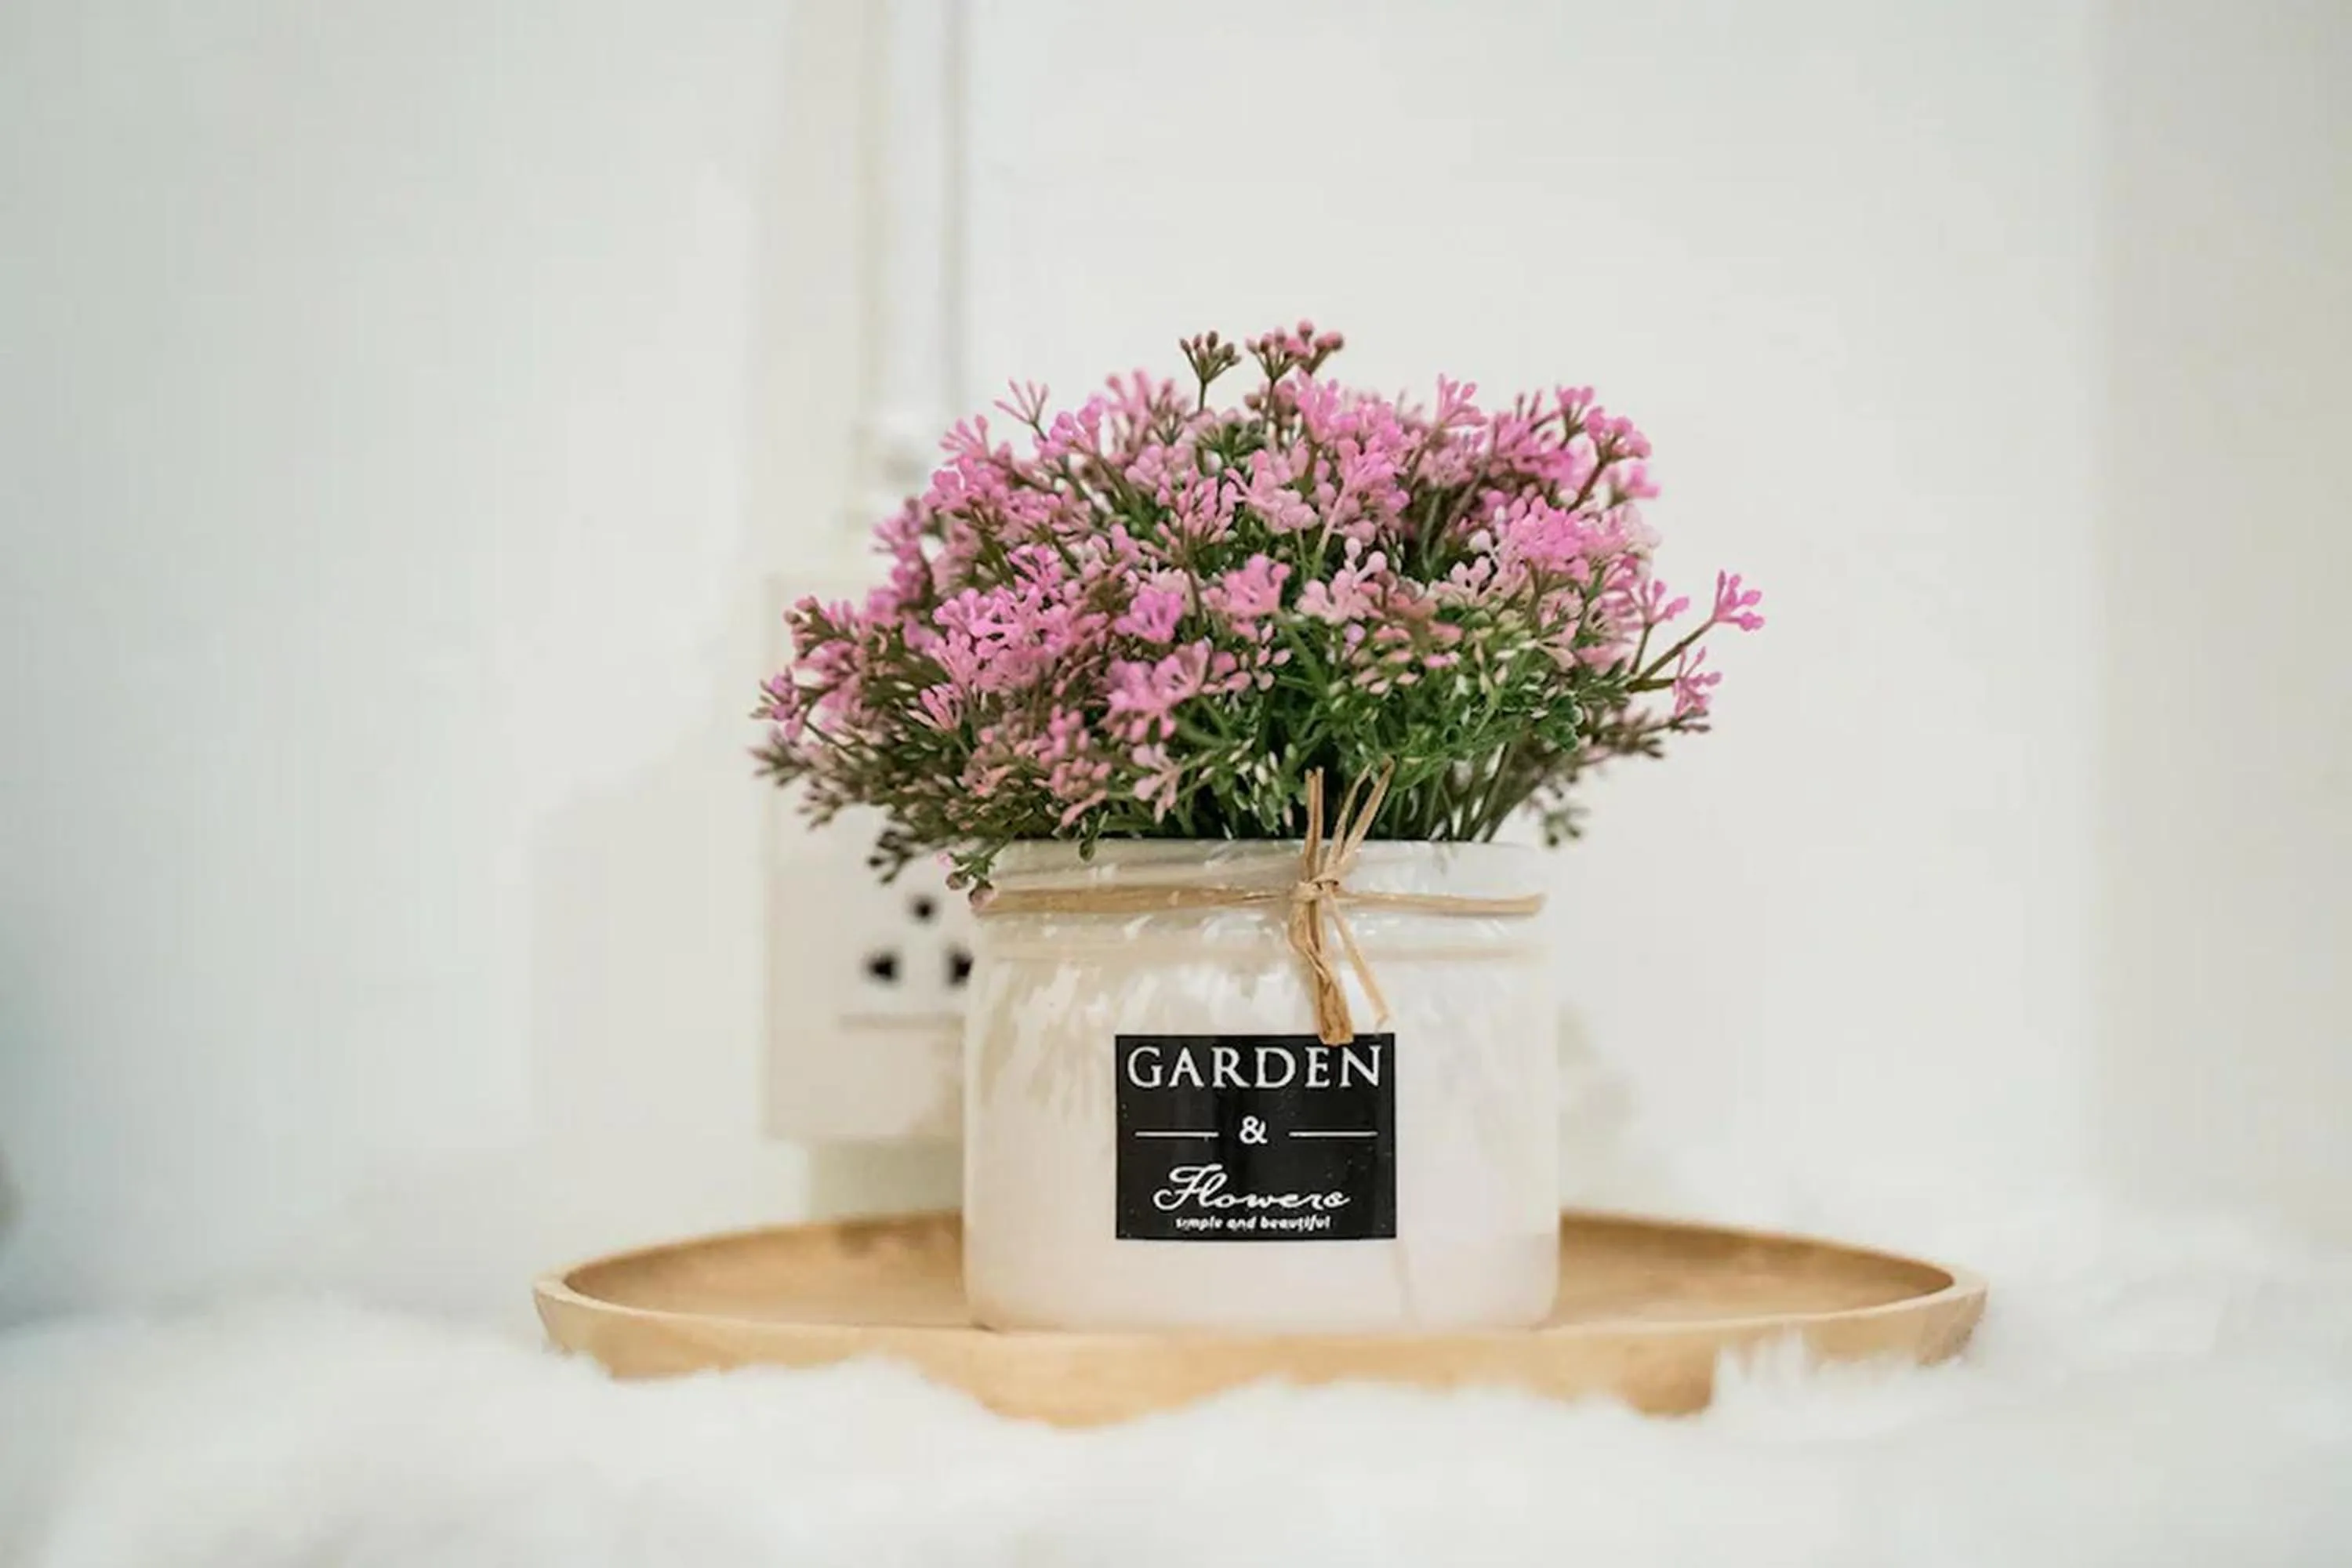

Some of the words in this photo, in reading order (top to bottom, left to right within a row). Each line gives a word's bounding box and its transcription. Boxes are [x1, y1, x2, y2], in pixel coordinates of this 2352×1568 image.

[1127, 1045, 1382, 1088] GARDEN
[1239, 1116, 1268, 1145] &
[1152, 1163, 1351, 1210] Flowers
[1175, 1215, 1223, 1231] simple
[1226, 1216, 1257, 1231] and
[1259, 1214, 1331, 1232] beautiful
